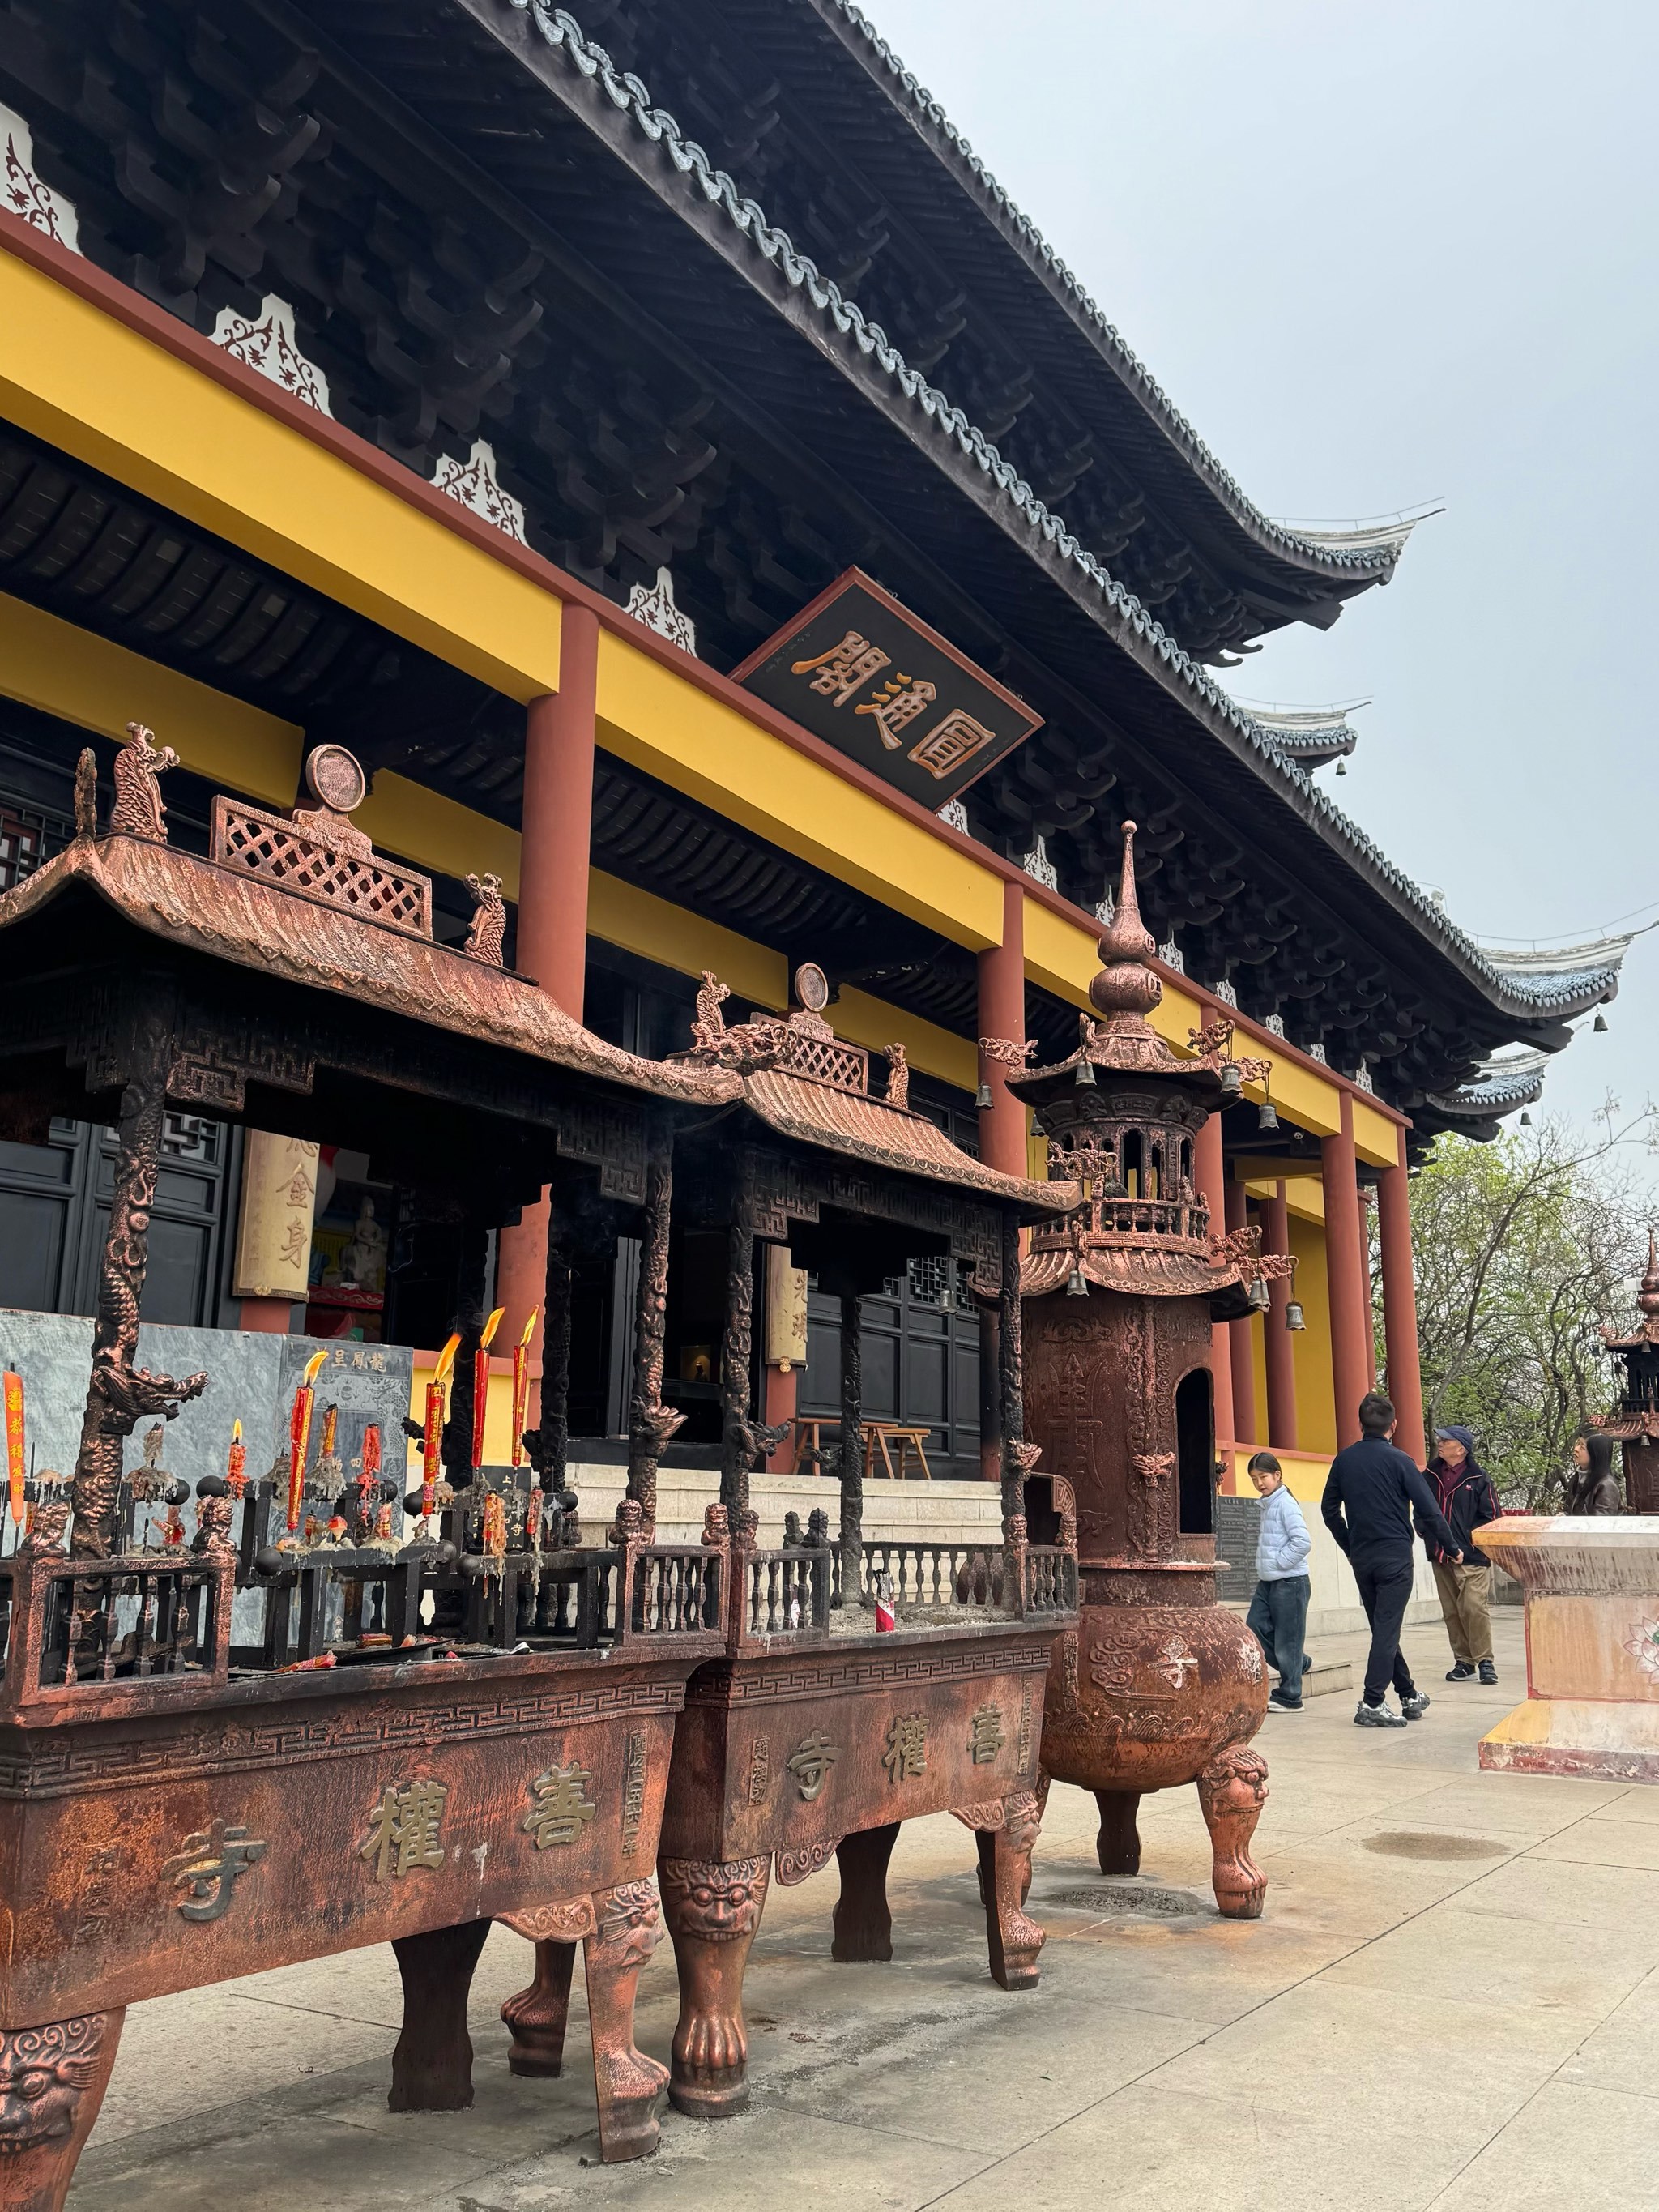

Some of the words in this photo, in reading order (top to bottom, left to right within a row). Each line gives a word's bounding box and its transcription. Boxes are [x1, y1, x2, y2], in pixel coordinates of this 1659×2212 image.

[791, 630, 996, 780] 圓通閣
[317, 1347, 387, 1373] 龍鳳呈
[788, 1702, 1007, 1801] 善權寺
[163, 1760, 596, 1921] 善權寺
